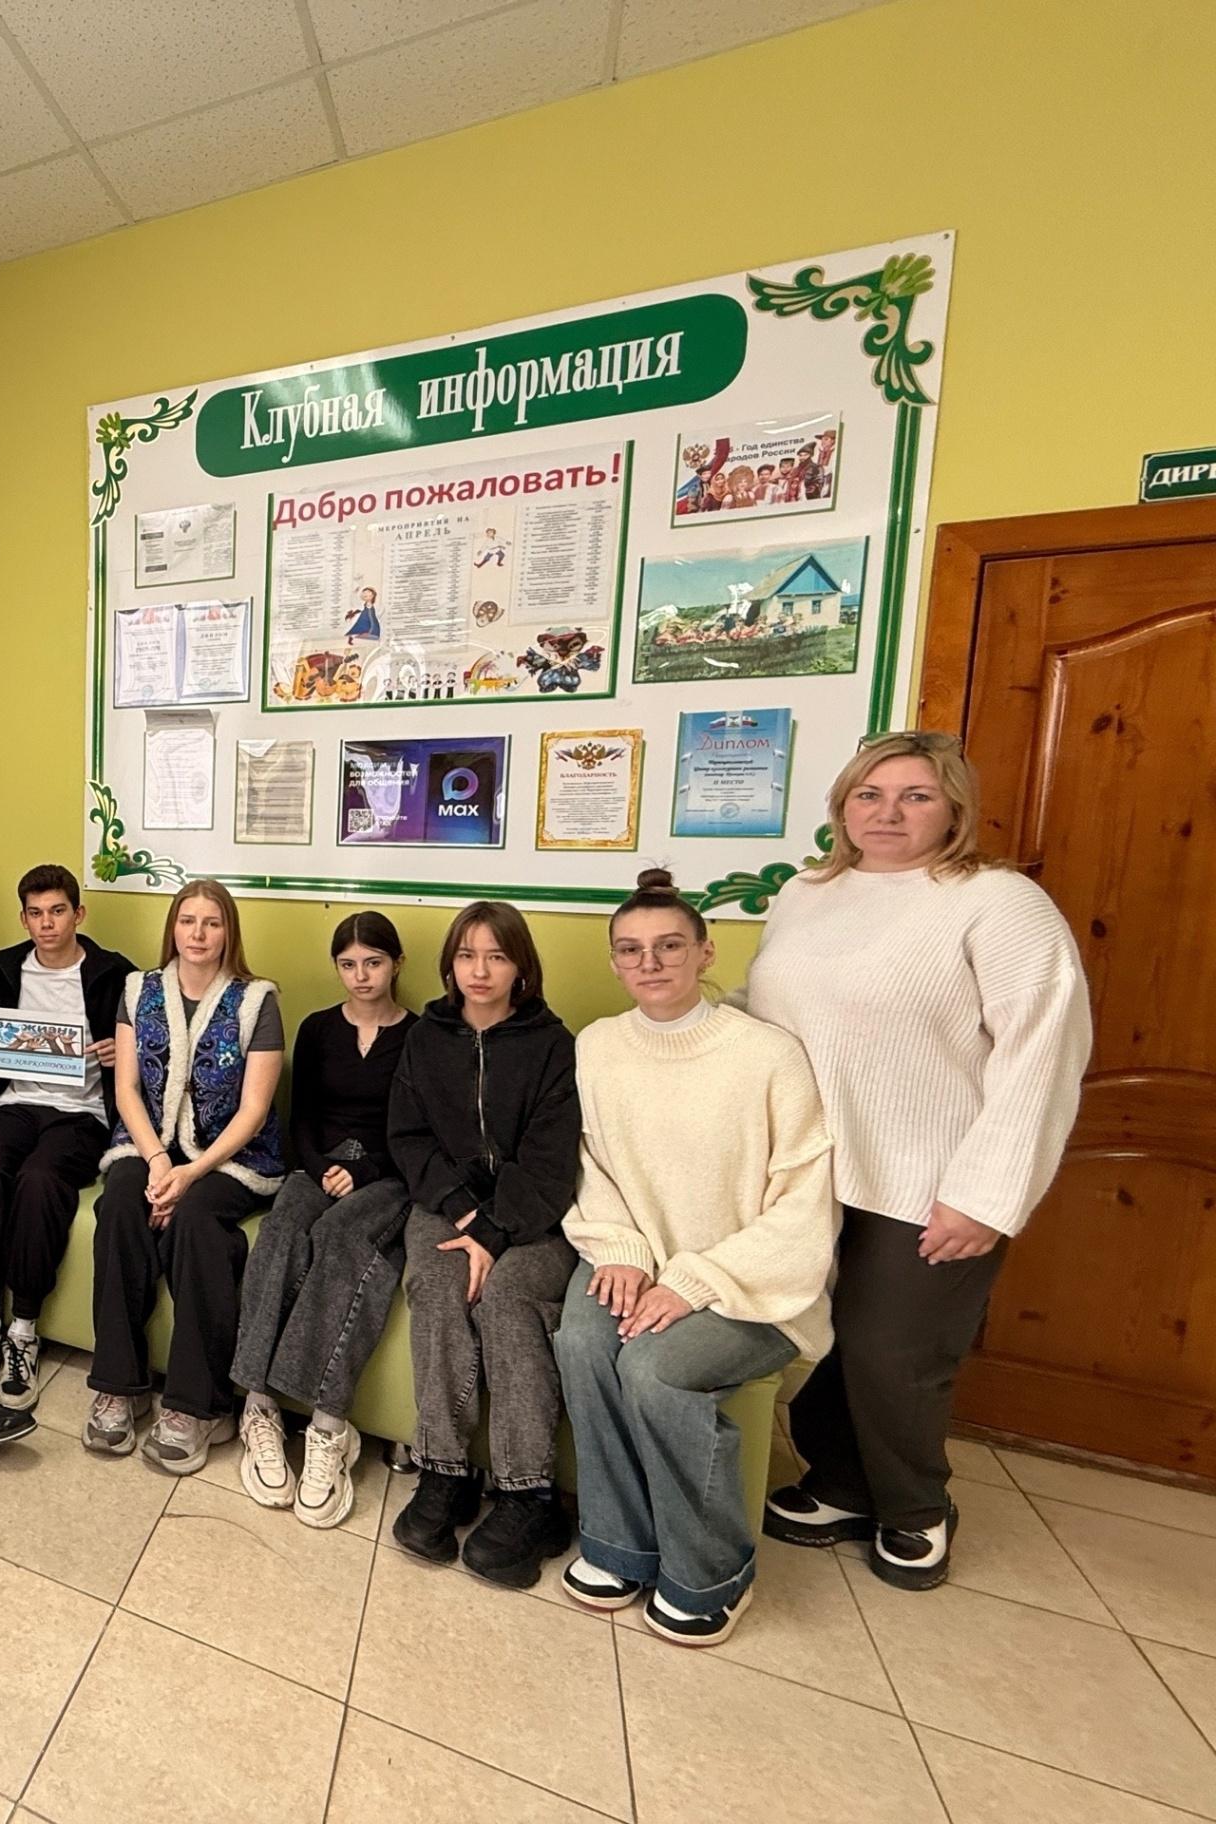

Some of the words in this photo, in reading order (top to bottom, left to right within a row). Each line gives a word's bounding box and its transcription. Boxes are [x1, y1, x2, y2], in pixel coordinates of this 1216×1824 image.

[240, 384, 387, 463] Клубная
[416, 331, 684, 432] информация
[741, 443, 758, 451] Год
[760, 437, 805, 449] единства
[762, 448, 796, 458] России
[272, 490, 377, 530] Добро
[384, 453, 622, 511] пожаловать!
[395, 527, 451, 541] АПРЕЛЬ
